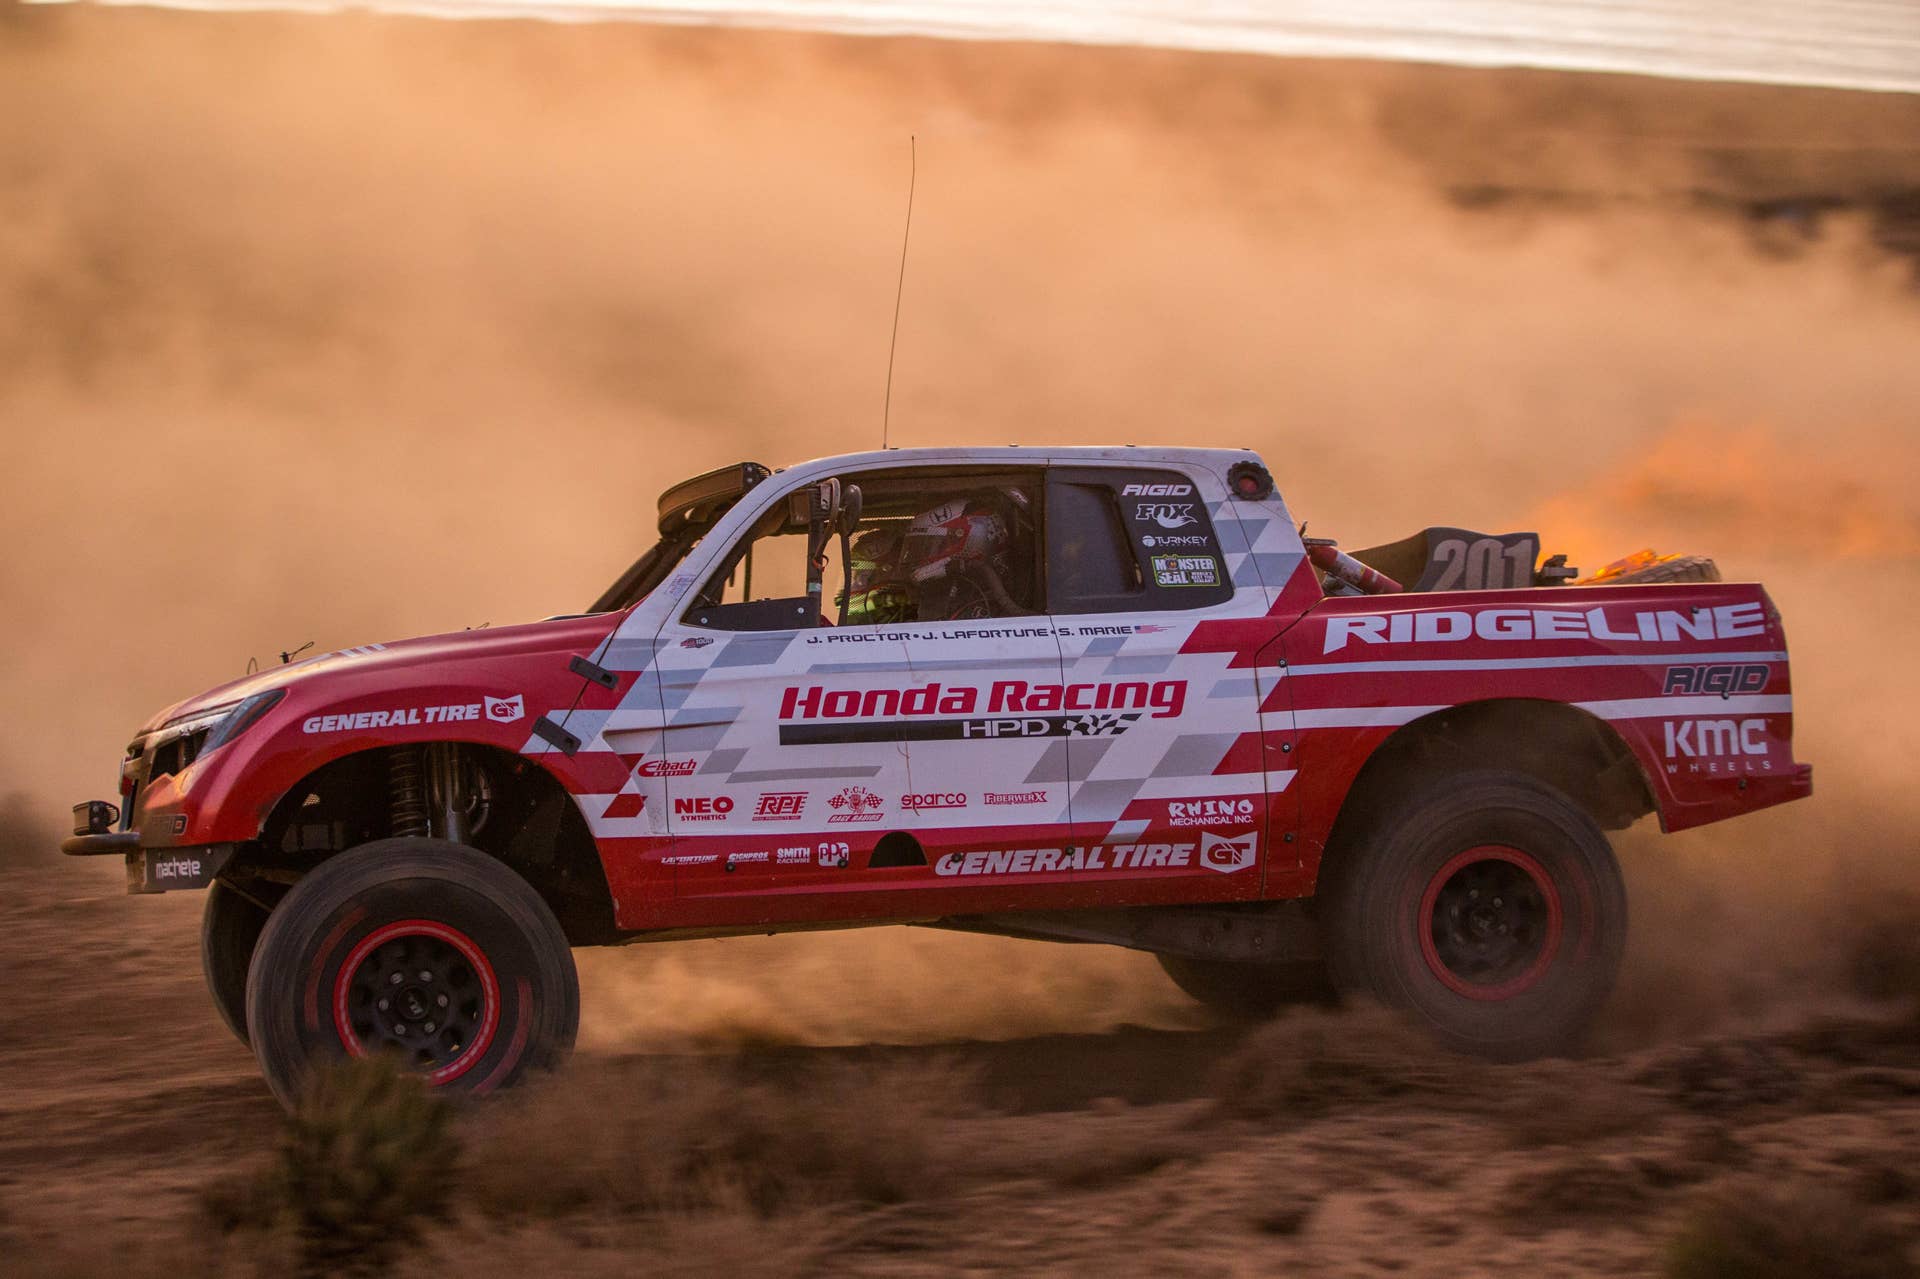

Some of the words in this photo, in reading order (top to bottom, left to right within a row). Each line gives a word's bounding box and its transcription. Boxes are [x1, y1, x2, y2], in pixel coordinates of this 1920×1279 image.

[1122, 484, 1193, 497] RIGID
[1135, 503, 1195, 526] FOX
[1155, 536, 1208, 544] TURNKEY
[1154, 558, 1215, 570] MONSTER
[1428, 538, 1533, 593] 201
[1158, 571, 1189, 584] SEAL
[806, 636, 823, 644] J.
[827, 632, 911, 643] PROCTOR
[942, 628, 1049, 640] LAFORTUNE
[1078, 625, 1133, 636] MARIE
[1323, 602, 1765, 656] RIDGELINE
[1661, 664, 1771, 695] RIGID
[778, 683, 978, 719] Honda
[986, 679, 1188, 719] Racing
[302, 708, 421, 734] GENERAL
[424, 703, 482, 723] TIRE
[963, 719, 1050, 738] HPD
[638, 758, 697, 777] Eibach
[1666, 760, 1772, 774] WHEELS
[675, 796, 735, 814] NEO
[758, 795, 804, 816] RPI
[901, 793, 967, 809] sparco
[1168, 799, 1254, 817] RHINO
[680, 814, 727, 822] SYNTHETICS
[1169, 816, 1233, 826] MECHANICAL
[777, 847, 811, 858] SMITH
[934, 846, 1107, 876] GENERAL
[1111, 843, 1196, 868] TIRE
[155, 856, 201, 880] machete
